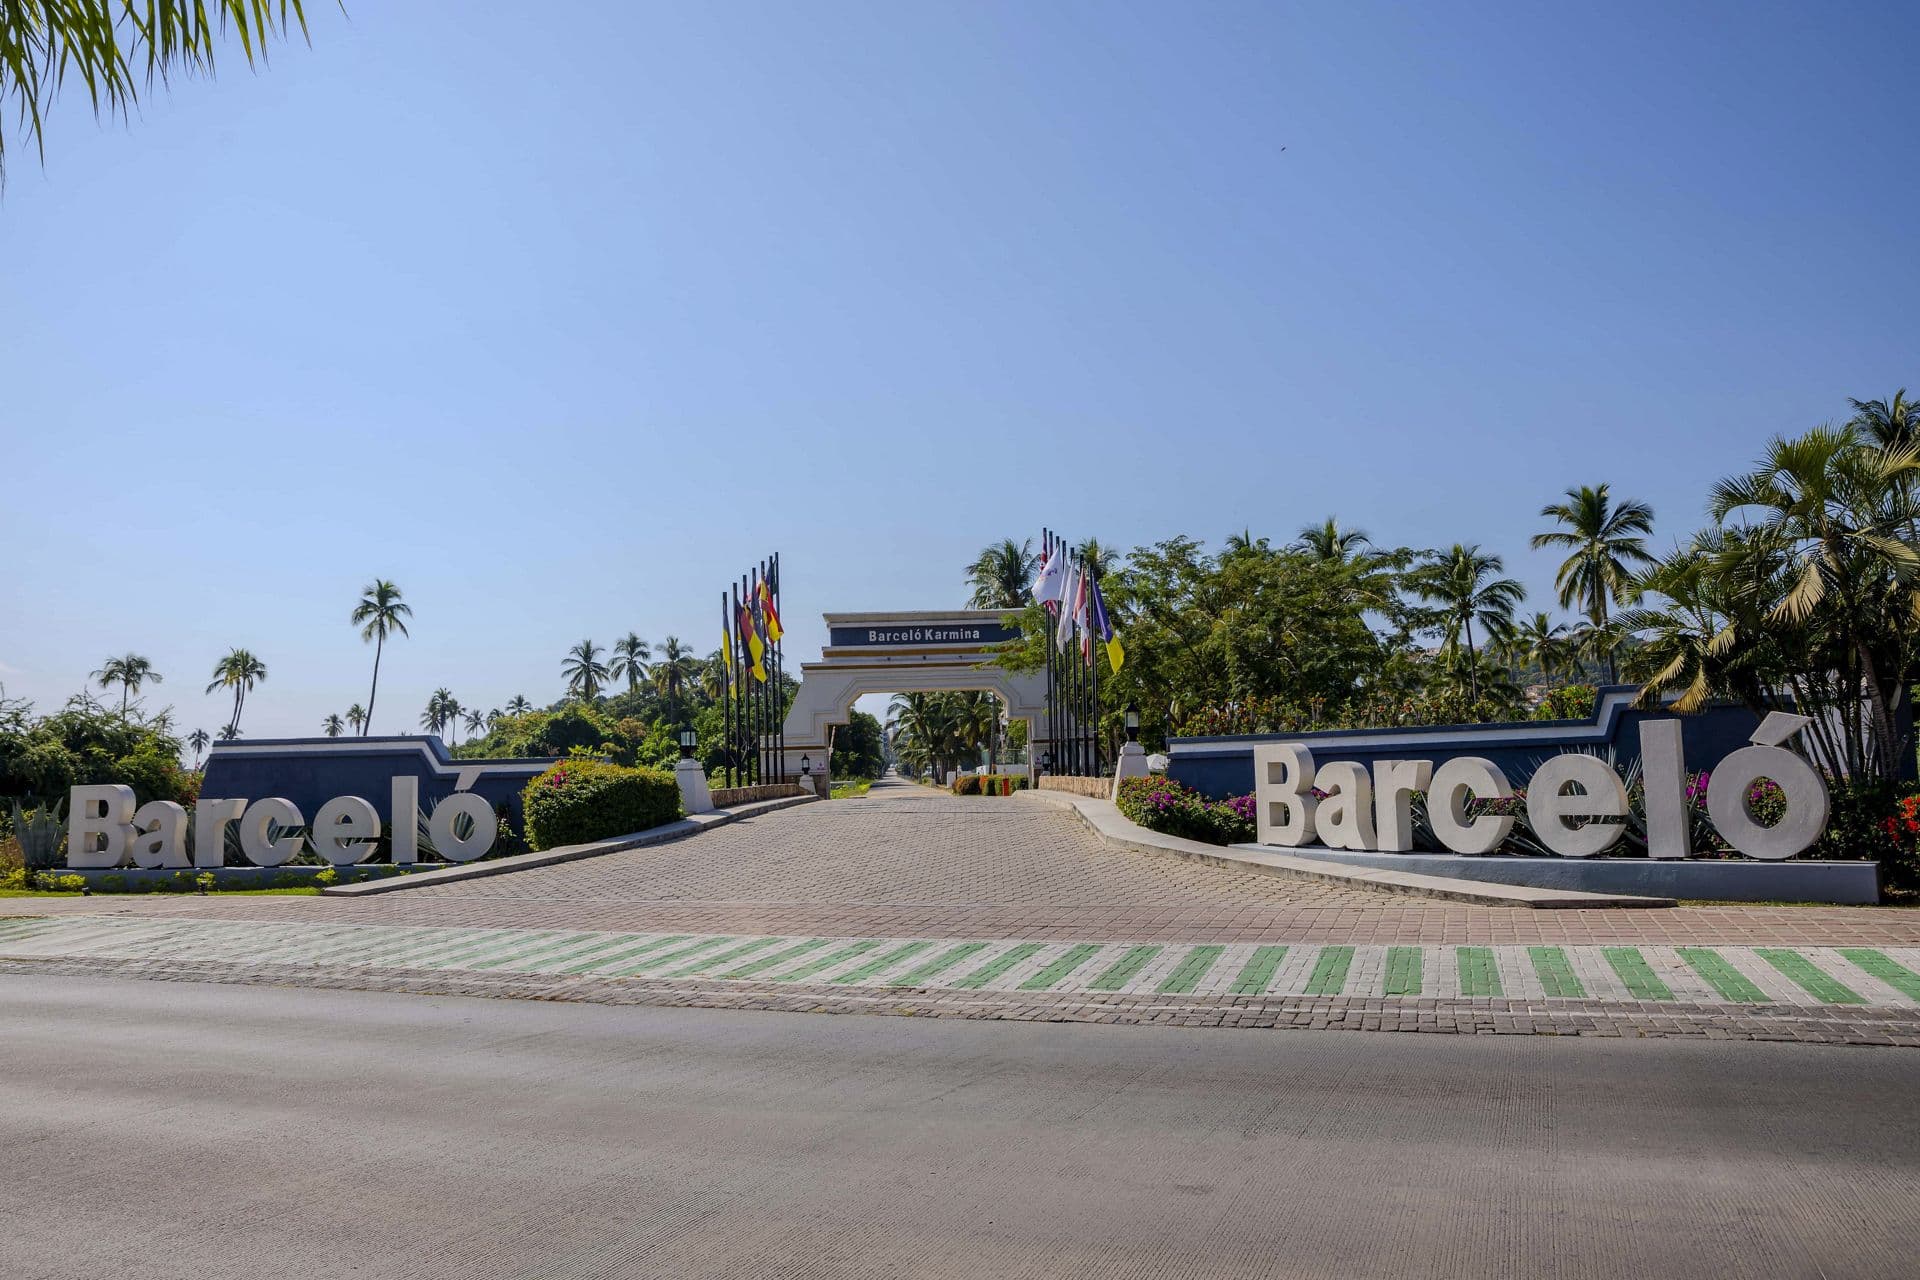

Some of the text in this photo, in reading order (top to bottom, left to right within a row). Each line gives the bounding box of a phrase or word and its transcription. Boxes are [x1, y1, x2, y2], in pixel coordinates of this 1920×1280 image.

[868, 628, 980, 642] Barceló Karmina
[67, 768, 497, 868] Barceló
[1254, 711, 1829, 859] Barceló
